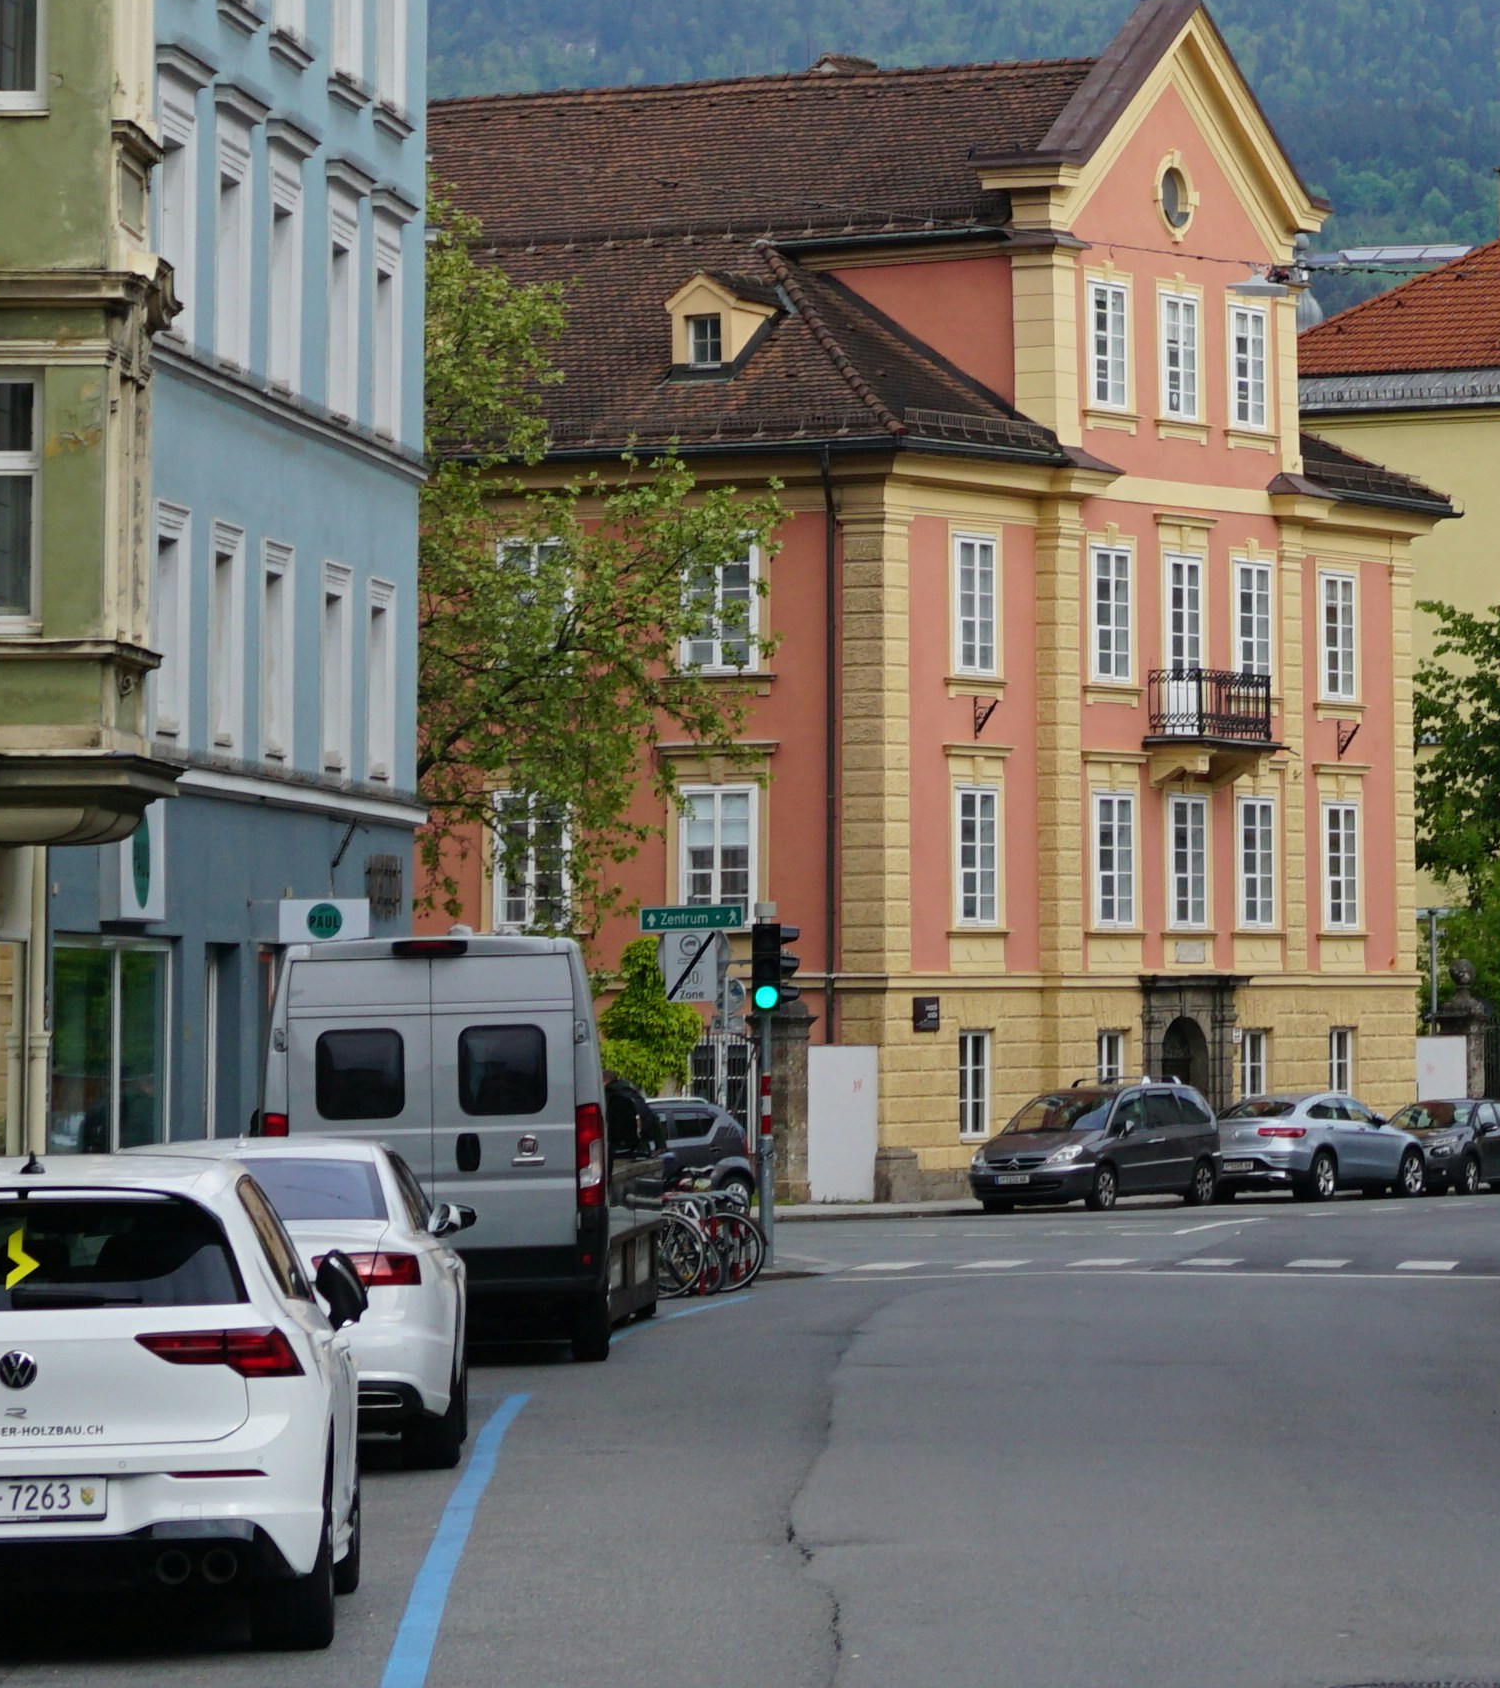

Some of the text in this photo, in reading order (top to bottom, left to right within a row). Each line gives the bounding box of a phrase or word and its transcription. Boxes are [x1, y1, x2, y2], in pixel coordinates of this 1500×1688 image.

[308, 914, 340, 930] PAUL
[660, 912, 708, 925] Zentrum
[680, 990, 704, 1000] Zone
